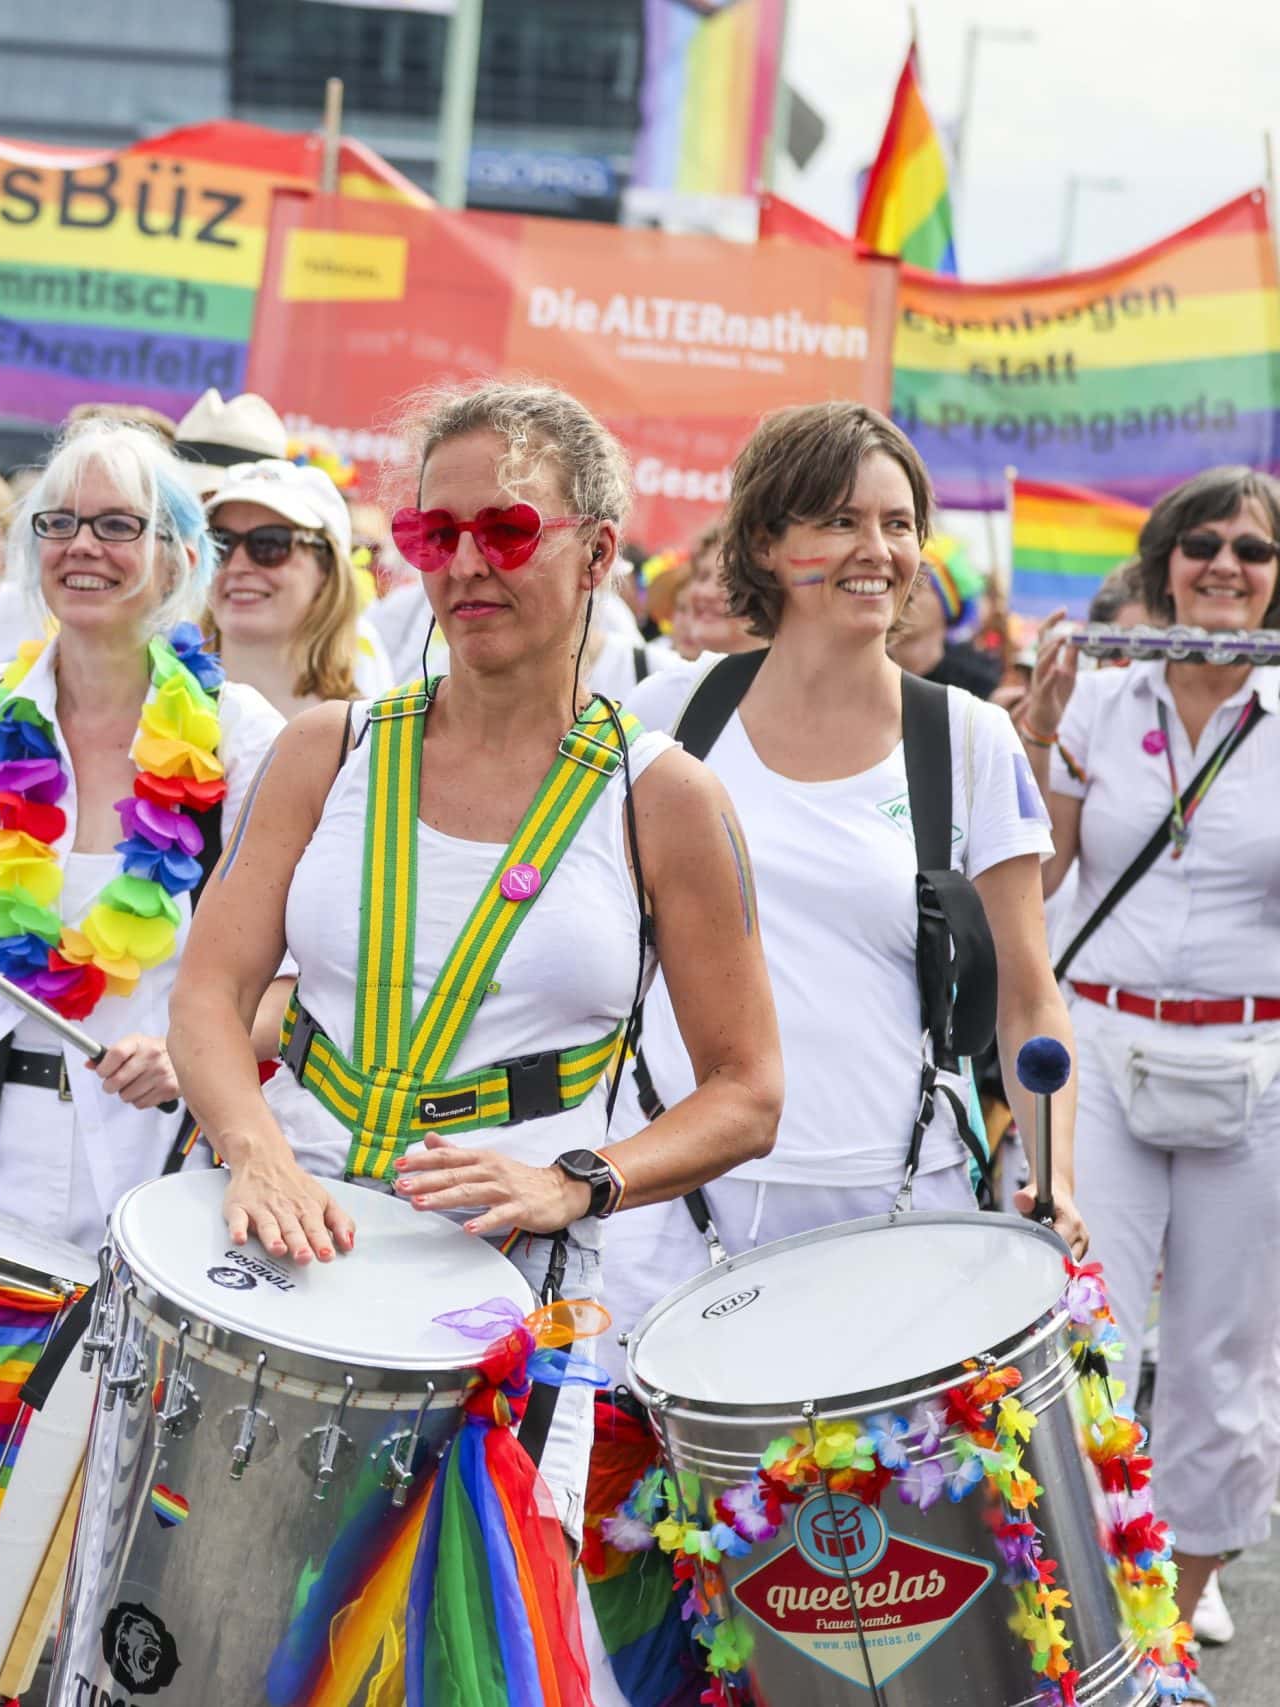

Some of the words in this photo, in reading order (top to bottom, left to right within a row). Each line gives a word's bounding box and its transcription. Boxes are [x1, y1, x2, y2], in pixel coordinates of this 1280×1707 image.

[528, 286, 598, 333] Die
[601, 293, 869, 360] ALTERnativen
[968, 352, 1078, 387] statt
[937, 393, 1238, 453] Propaganda
[766, 1568, 947, 1619] queerelas
